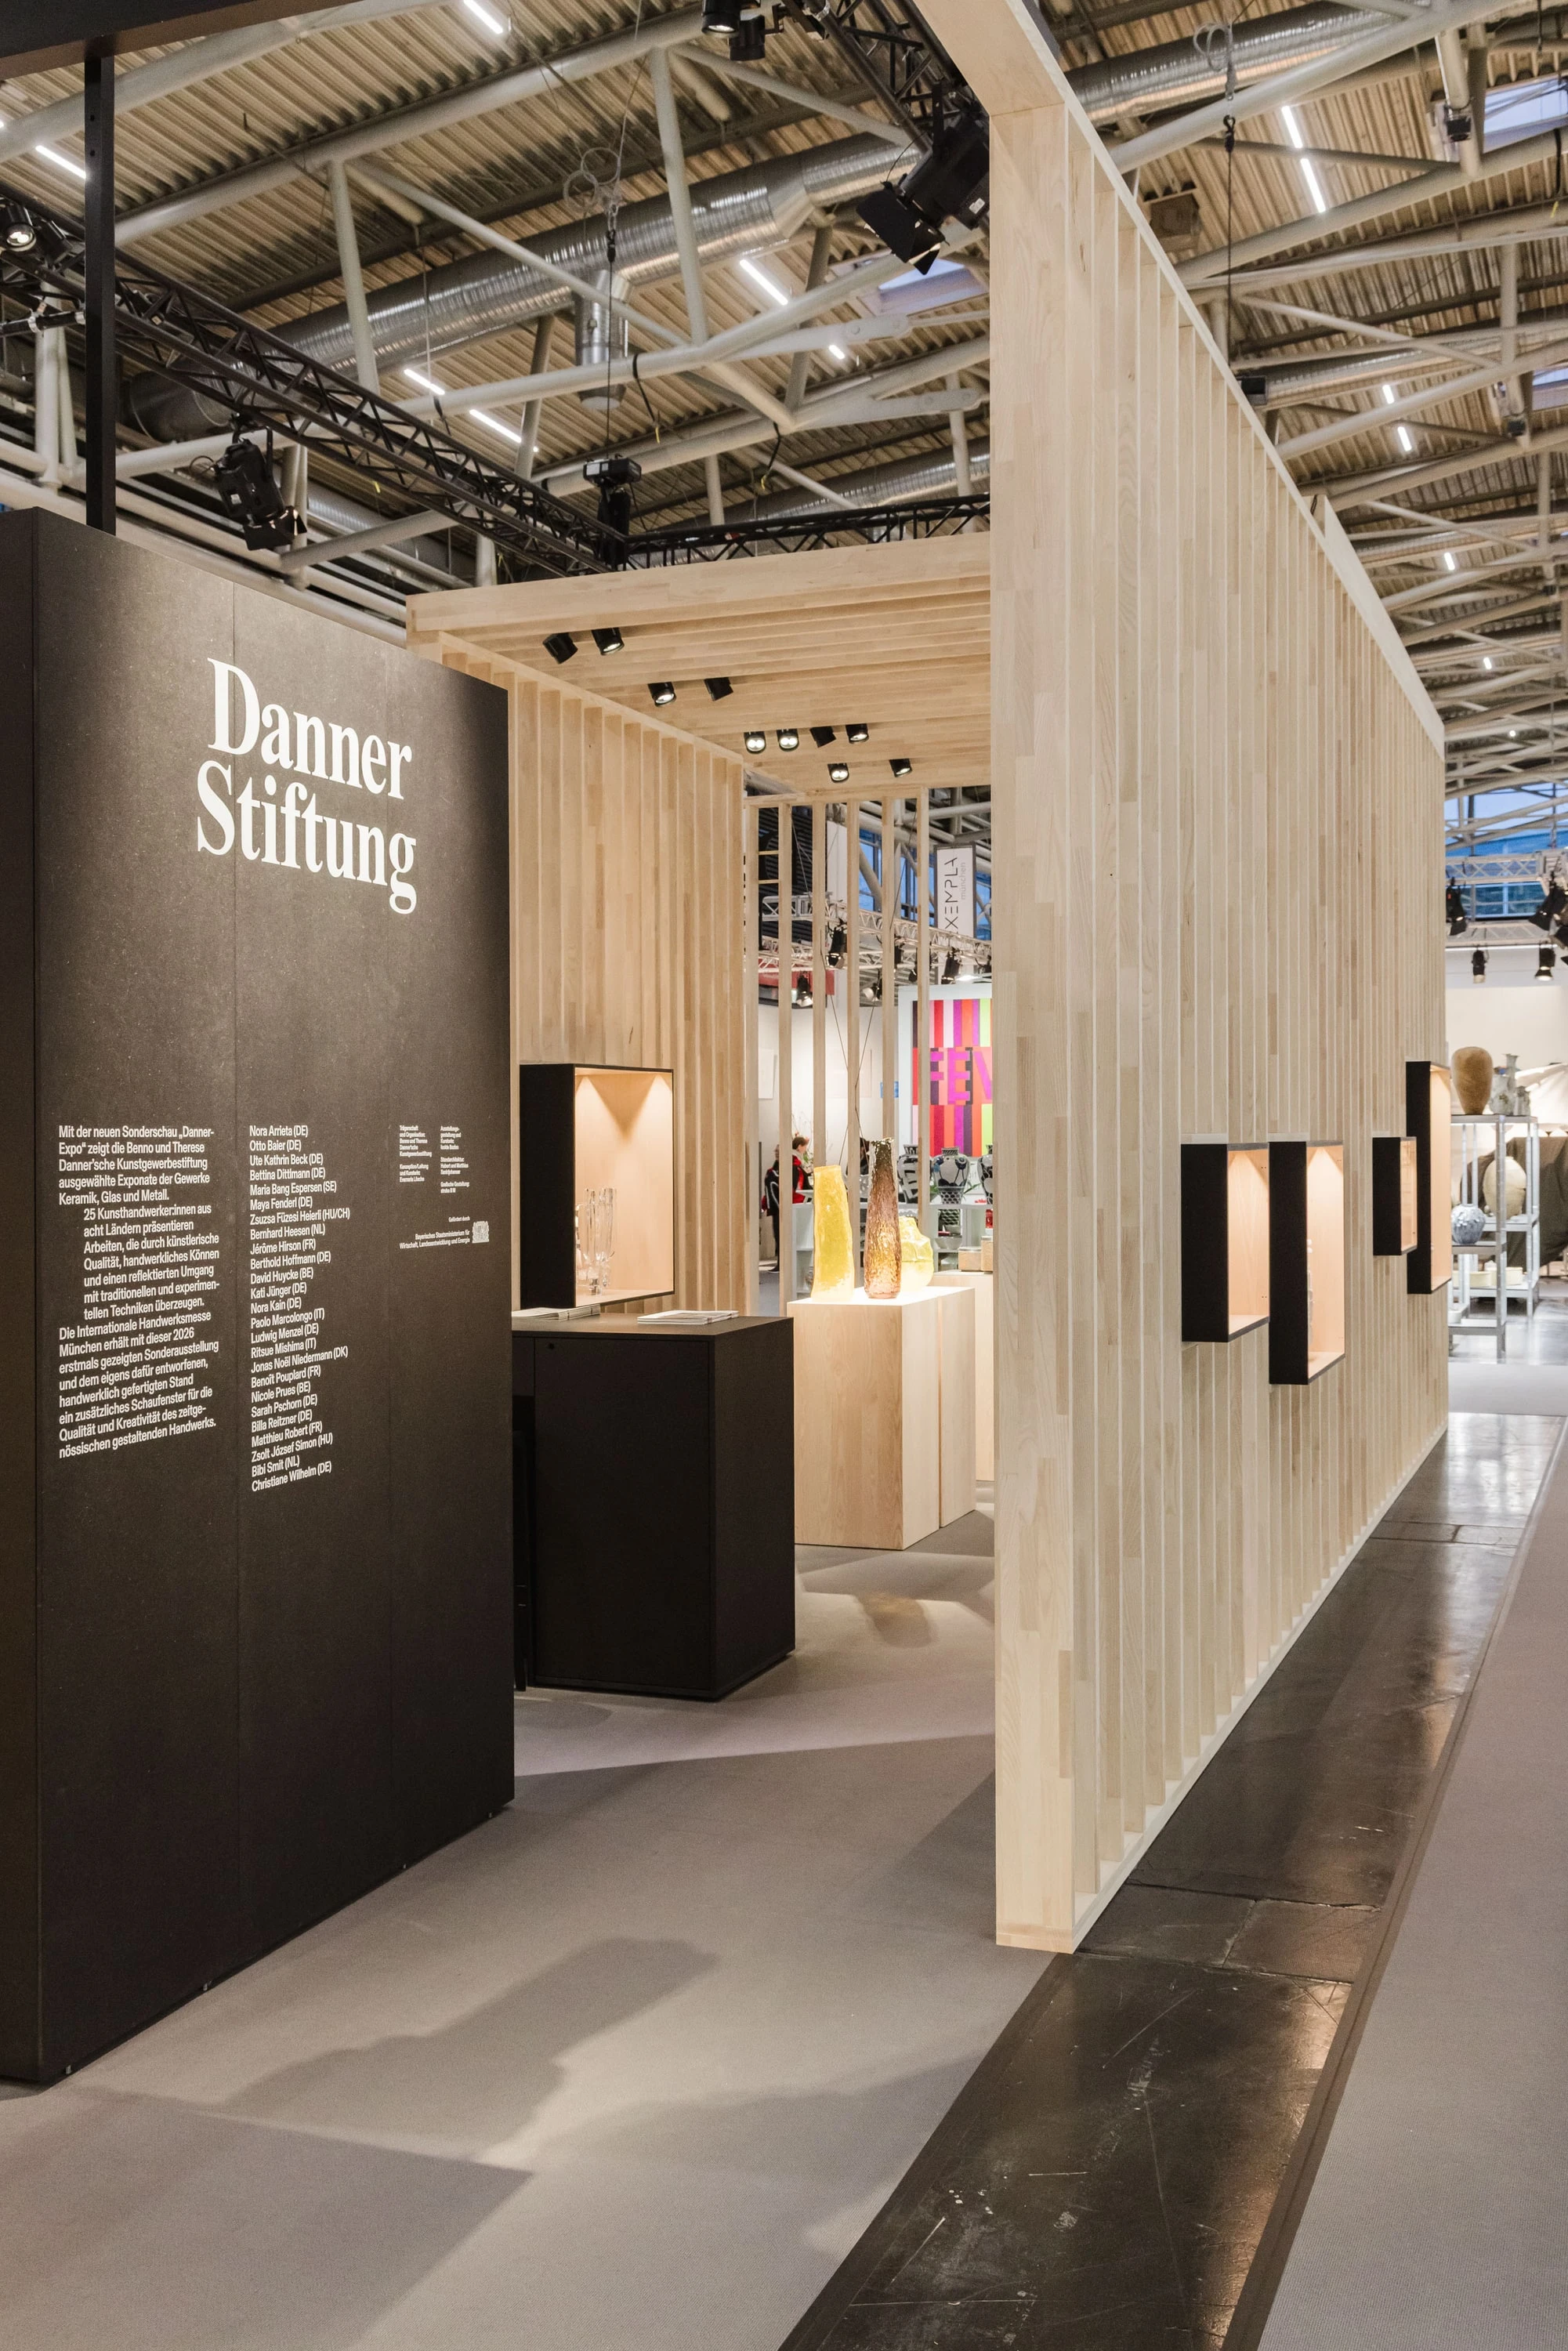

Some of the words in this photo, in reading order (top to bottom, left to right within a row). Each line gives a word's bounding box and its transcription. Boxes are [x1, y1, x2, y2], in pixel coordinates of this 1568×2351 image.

[207, 657, 413, 800] Danner
[197, 759, 418, 915] Stiftung
[943, 857, 958, 934] XEMPLA
[59, 1125, 74, 1138] Mit
[75, 1125, 92, 1138] der
[93, 1128, 121, 1137] neuen
[121, 1125, 177, 1137] Sonderschau
[249, 1125, 267, 1136] Nora
[268, 1125, 292, 1136] Arrieta
[293, 1124, 308, 1138] (DE)
[87, 1141, 110, 1157] zeigt
[111, 1141, 125, 1154] die
[126, 1141, 154, 1154] Benno
[154, 1141, 171, 1153] und
[172, 1140, 205, 1153] Therese
[249, 1139, 266, 1151] Otto
[267, 1139, 285, 1150] Baier
[286, 1139, 301, 1152] (DE)
[117, 1156, 208, 1172] Kunstgewerbestiftung
[249, 1154, 263, 1166] Ute
[263, 1154, 289, 1165] Kathrin
[290, 1153, 308, 1165] Beck
[309, 1153, 323, 1166] (DE)
[58, 1174, 116, 1190] ausgewählte
[118, 1173, 158, 1188] Exponate
[158, 1172, 173, 1185] der
[174, 1171, 210, 1184] Gewerke
[249, 1168, 275, 1181] Bettina
[277, 1168, 310, 1179] Dittlmann
[311, 1166, 325, 1180] (DE)
[59, 1190, 100, 1205] Keramik,
[100, 1190, 121, 1203] Glas
[122, 1189, 139, 1202] und
[141, 1188, 169, 1201] Metall.
[249, 1183, 270, 1196] Maria
[271, 1183, 290, 1196] Bang
[291, 1182, 322, 1195] Espersen
[323, 1179, 336, 1194] (SE)
[83, 1207, 96, 1220] 25
[97, 1203, 196, 1219] Kunsthandwerker:innen
[197, 1204, 212, 1214] aus
[250, 1198, 270, 1212] Maya
[270, 1196, 297, 1209] Fenderl
[298, 1195, 313, 1209] (DE)
[249, 1213, 275, 1225] Zsuzsa
[276, 1210, 299, 1223] Füzesi
[299, 1208, 321, 1221] Heierli
[322, 1207, 350, 1222] (HU/CH)
[83, 1223, 103, 1237] acht
[105, 1222, 141, 1235] Ländern
[143, 1219, 194, 1236] präsentieren
[250, 1226, 283, 1240] Bernhard
[284, 1226, 310, 1237] Heesen
[310, 1223, 325, 1237] (NL)
[83, 1239, 125, 1254] Arbeiten,
[125, 1237, 139, 1251] die
[140, 1235, 165, 1249] durch
[166, 1232, 219, 1247] künstlerische
[250, 1242, 277, 1255] Jérôme
[278, 1240, 301, 1252] Hirson
[302, 1237, 316, 1252] (FR)
[83, 1255, 121, 1270] Qualität,
[123, 1250, 188, 1266] handwerkliches
[190, 1248, 219, 1261] Können
[250, 1255, 281, 1270] Berthold
[282, 1253, 316, 1266] Hoffmann
[317, 1250, 331, 1264] (DE)
[84, 1273, 101, 1287] und
[103, 1272, 127, 1285] einen
[129, 1267, 179, 1283] reflektierten
[180, 1265, 214, 1278] Umgang
[250, 1270, 271, 1284] David
[272, 1268, 299, 1283] Huycke
[299, 1266, 313, 1281] (BE)
[84, 1290, 99, 1303] mit
[100, 1284, 156, 1302] traditionellen
[158, 1281, 173, 1295] und
[175, 1279, 219, 1295] experimen-
[251, 1286, 265, 1299] Kati
[266, 1284, 291, 1298] Jünger
[292, 1281, 306, 1295] (DE)
[83, 1306, 108, 1320] tellen
[110, 1301, 154, 1317] Techniken
[155, 1297, 205, 1311] überzeugen.
[251, 1302, 269, 1314] Nora
[270, 1299, 285, 1311] Kain
[286, 1295, 302, 1311] (DE)
[59, 1326, 75, 1340] Die
[77, 1318, 137, 1338] Internationale
[139, 1311, 211, 1329] Handwerksmesse
[250, 1315, 270, 1329] Paolo
[272, 1311, 313, 1325] Marcolongo
[313, 1307, 324, 1321] (IT)
[60, 1340, 102, 1357] München
[103, 1335, 129, 1350] erhält
[130, 1333, 144, 1347] mit
[146, 1331, 172, 1344] dieser
[172, 1326, 194, 1341] 2026
[251, 1329, 277, 1344] Ludwig
[278, 1324, 303, 1339] Menzel
[304, 1322, 319, 1337] (DE)
[59, 1356, 99, 1374] erstmals
[100, 1351, 143, 1370] gezeigten
[144, 1339, 219, 1360] Sonderausstellung
[251, 1346, 273, 1358] Ritsue
[274, 1340, 304, 1354] Mishima
[305, 1336, 316, 1351] (IT)
[251, 1361, 273, 1373] Jonas
[273, 1355, 291, 1369] Noël
[292, 1350, 332, 1366] Niedermann
[333, 1345, 348, 1360] (DK)
[59, 1375, 77, 1390] und
[78, 1374, 99, 1387] dem
[100, 1370, 130, 1386] eigens
[131, 1364, 154, 1378] dafür
[155, 1357, 208, 1375] entworfenen,
[251, 1373, 274, 1388] Benoît
[276, 1367, 306, 1383] Pouplard
[307, 1364, 320, 1379] (FR)
[59, 1386, 119, 1407] handwerklich
[121, 1379, 168, 1400] gefertigten
[168, 1372, 194, 1388] Stand
[251, 1388, 274, 1403] Nicole
[275, 1386, 295, 1398] Prues
[295, 1380, 310, 1396] (BE)
[59, 1411, 73, 1425] ein
[74, 1401, 129, 1422] zusätzliches
[131, 1391, 186, 1411] Schaufenster
[187, 1387, 199, 1400] für
[200, 1386, 212, 1398] die
[251, 1403, 273, 1418] Sarah
[273, 1399, 302, 1413] Pschorn
[302, 1393, 317, 1408] (DE)
[59, 1422, 96, 1441] Qualität
[97, 1418, 114, 1434] und
[114, 1410, 161, 1430] Kreativität
[161, 1408, 177, 1421] des
[178, 1404, 206, 1418] zeitge-
[251, 1419, 266, 1433] Billa
[268, 1414, 297, 1429] Reitzner
[297, 1408, 312, 1424] (DE)
[59, 1438, 110, 1458] nössischen
[111, 1425, 167, 1450] gestaltenden
[168, 1416, 216, 1436] Handwerks.
[251, 1431, 283, 1447] Matthieu
[284, 1424, 308, 1440] Robert
[309, 1420, 322, 1436] (FR)
[251, 1447, 270, 1462] Zsolt
[270, 1440, 294, 1458] József
[295, 1438, 317, 1451] Simon
[317, 1432, 332, 1447] (HU)
[252, 1462, 266, 1477] Bibi
[266, 1458, 284, 1473] Smit
[284, 1454, 299, 1470] (NL)
[252, 1474, 288, 1491] Christiane
[288, 1465, 317, 1482] Wilhelm
[317, 1460, 331, 1476] (DE)
